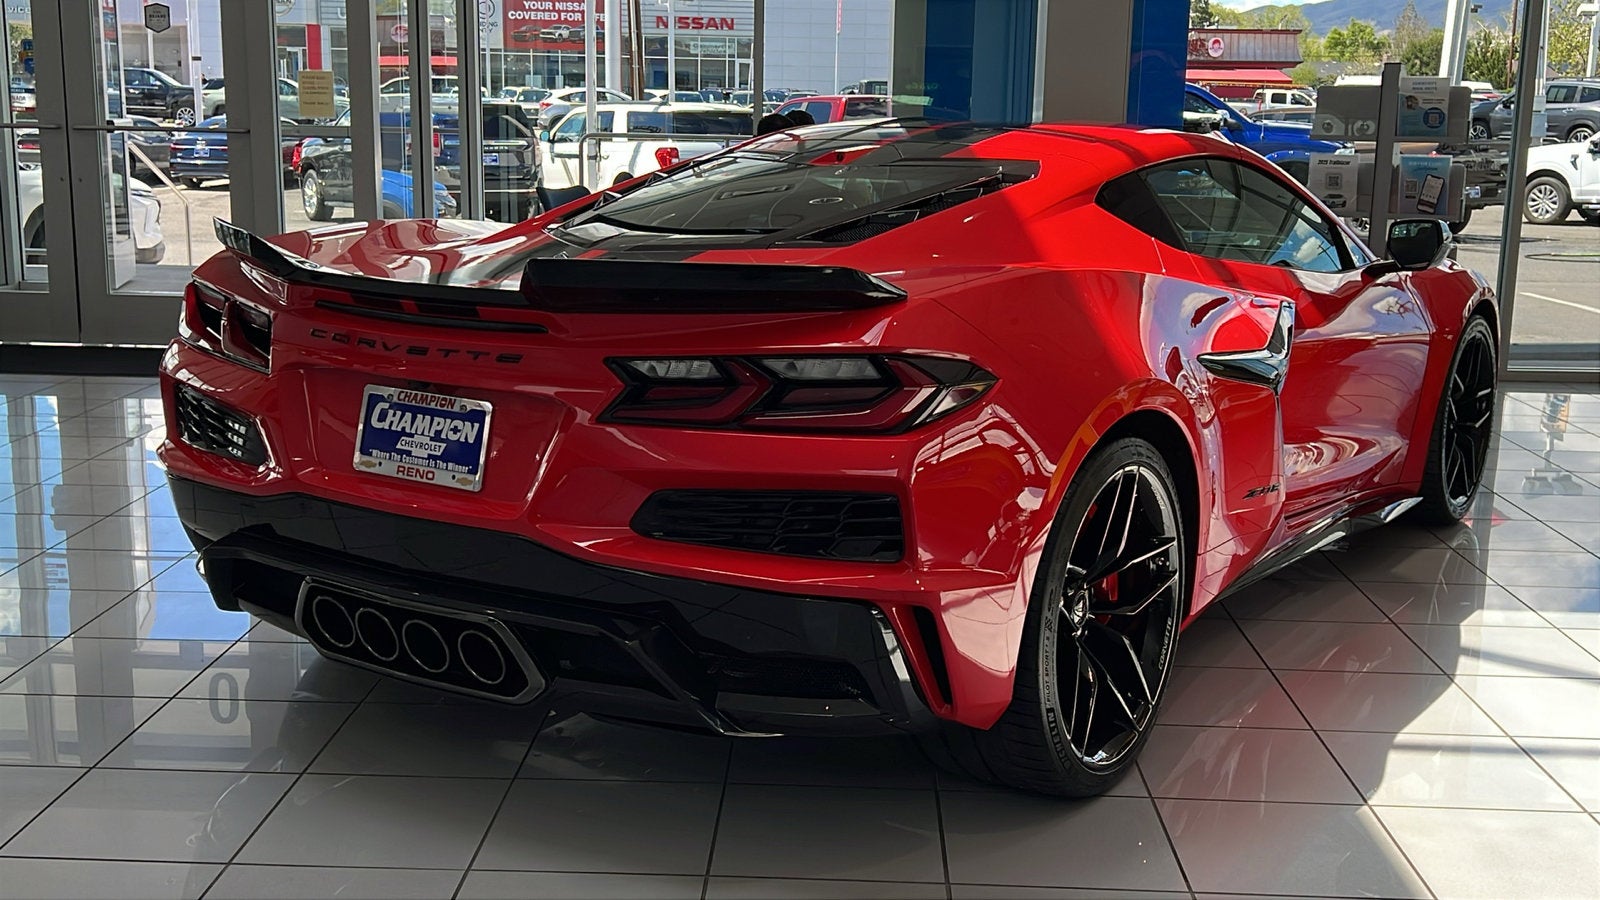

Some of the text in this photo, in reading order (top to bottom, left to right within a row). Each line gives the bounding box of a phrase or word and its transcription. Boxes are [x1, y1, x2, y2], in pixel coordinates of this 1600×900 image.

[523, 0, 586, 12] YOUR NISSA
[508, 10, 559, 21] COVERED
[561, 11, 582, 21] FOR
[656, 15, 735, 31] NSSAN
[310, 328, 525, 364] CORVETTE
[396, 390, 457, 410] CHAMPION
[371, 401, 479, 444] CHAMPION
[399, 437, 442, 453] CHEVROLET
[390, 451, 402, 463] The
[402, 453, 429, 467] Customer
[429, 459, 436, 467] Is
[436, 459, 447, 469] The
[396, 464, 436, 482] RENO
